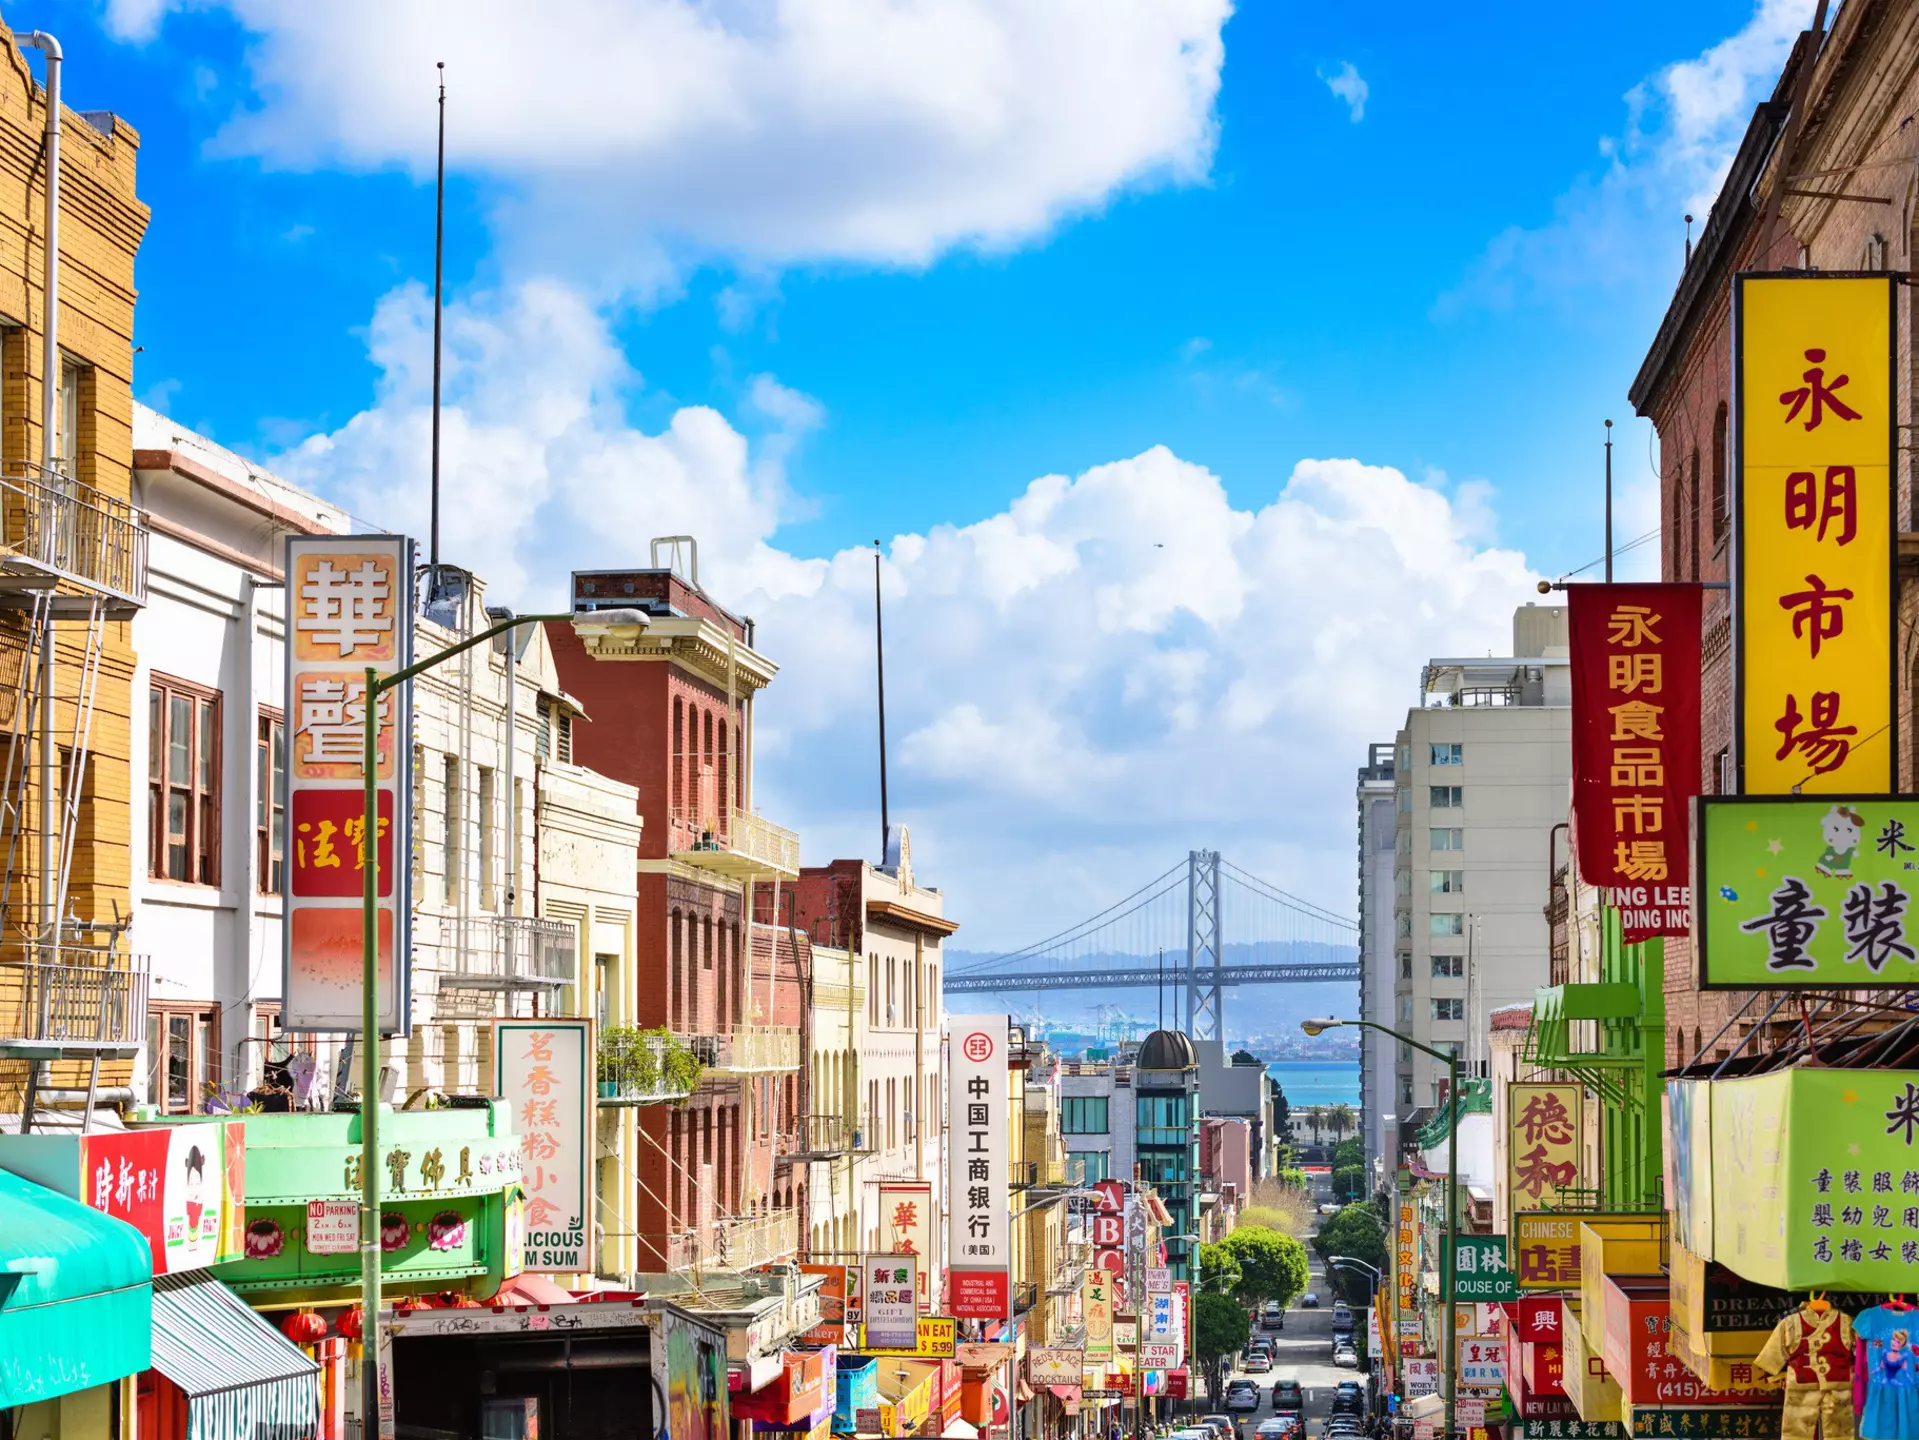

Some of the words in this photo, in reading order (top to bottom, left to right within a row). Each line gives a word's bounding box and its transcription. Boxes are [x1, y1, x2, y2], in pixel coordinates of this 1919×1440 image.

[1776, 348, 1863, 774] 永明市場
[1607, 604, 1668, 882] 永明食品市場
[1740, 878, 1917, 973] 童裝
[967, 1075, 991, 1238] 中国工商银行
[1513, 1092, 1578, 1211] 德和
[309, 1202, 324, 1217] NO
[325, 1204, 357, 1217] PARKING
[314, 1219, 320, 1229] 2
[337, 1219, 344, 1229] 6
[1521, 1222, 1574, 1239] CHINESE
[524, 1231, 584, 1248] ICIOUS
[962, 1244, 995, 1256] (美国)
[543, 1251, 579, 1266] SUM
[1495, 1280, 1512, 1293] OF
[1713, 1296, 1794, 1312] DREAM
[1532, 1310, 1558, 1331] 興
[932, 1325, 952, 1337] EAT
[932, 1341, 953, 1352] 5.99
[1151, 1346, 1175, 1356] STAR
[1056, 1352, 1080, 1369] PLACE
[1129, 1357, 1167, 1367] HEATER
[1032, 1374, 1081, 1384] COCKTAILS
[1526, 1402, 1545, 1414] NEW
[1547, 1402, 1561, 1413] LAI
